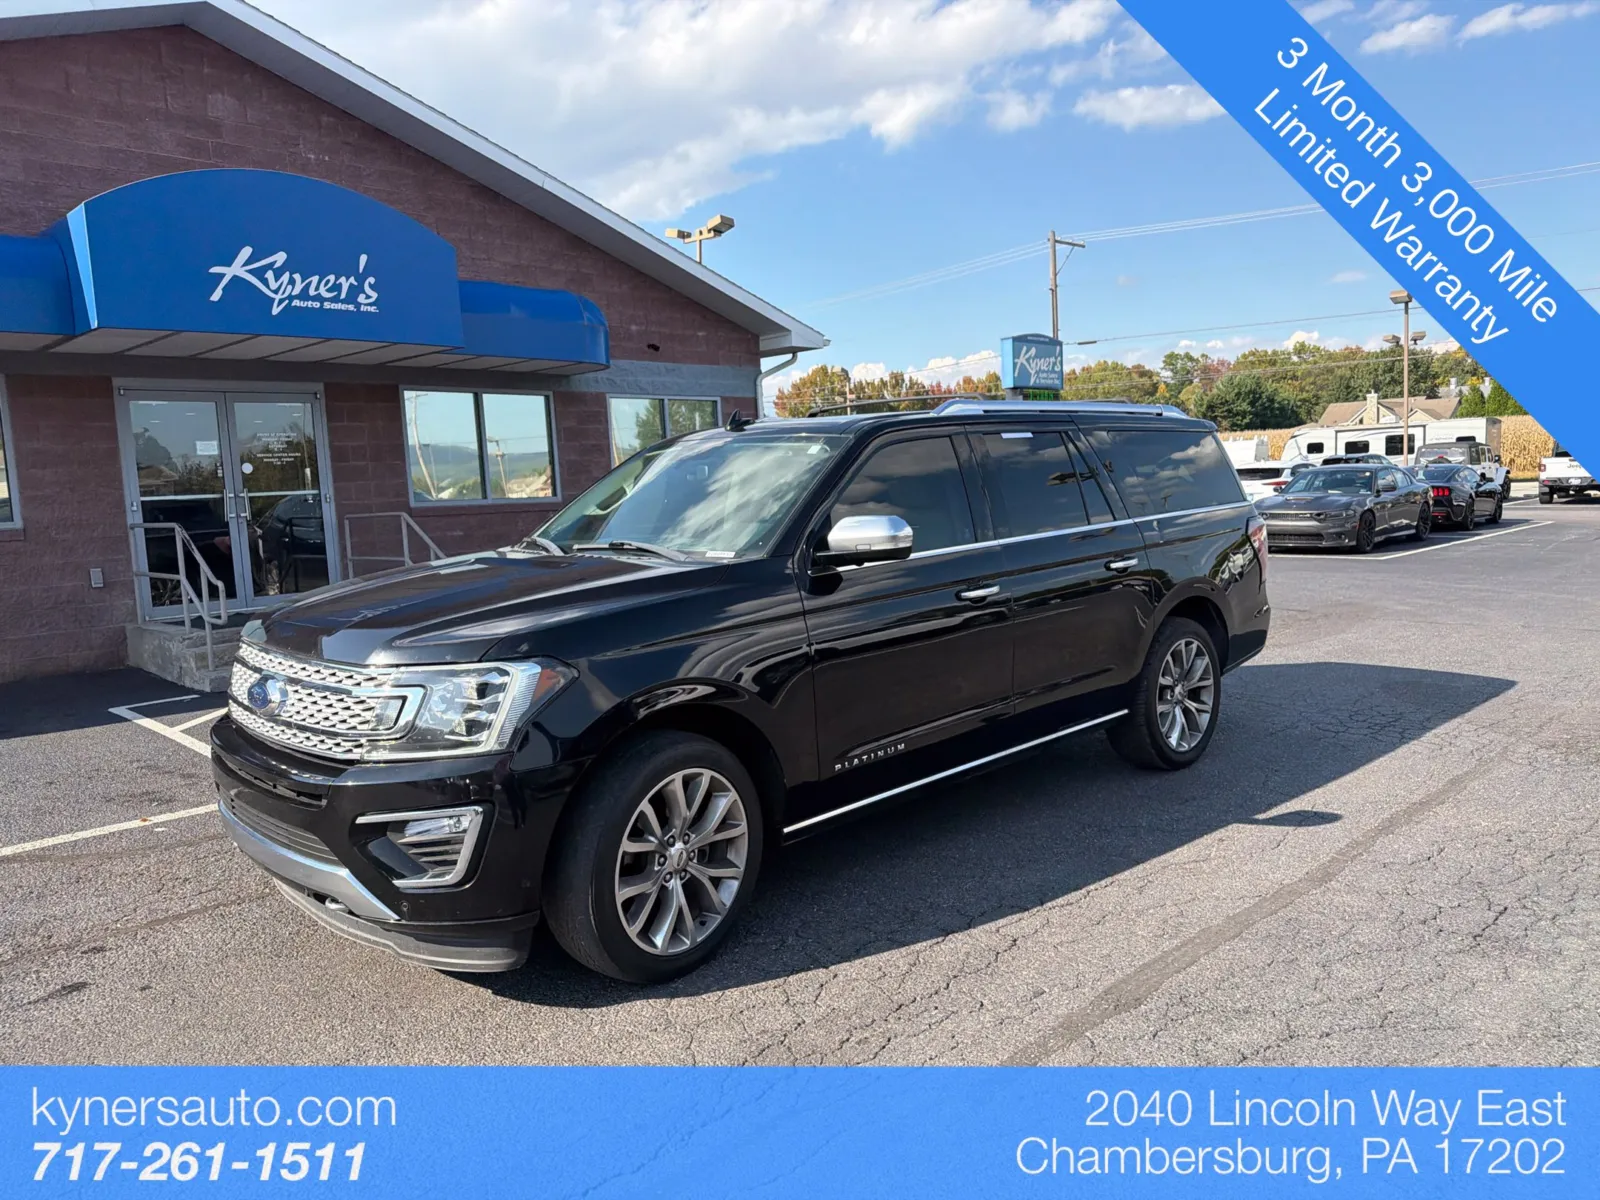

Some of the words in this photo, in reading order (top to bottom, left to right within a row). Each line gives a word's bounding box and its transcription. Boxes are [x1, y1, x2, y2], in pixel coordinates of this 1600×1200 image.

[208, 245, 378, 316] Kyner's
[291, 299, 321, 308] Auto
[323, 301, 357, 312] Sales,
[360, 304, 379, 313] Inc.
[1014, 345, 1061, 386] Kyner's
[834, 742, 906, 772] PLATINUM
